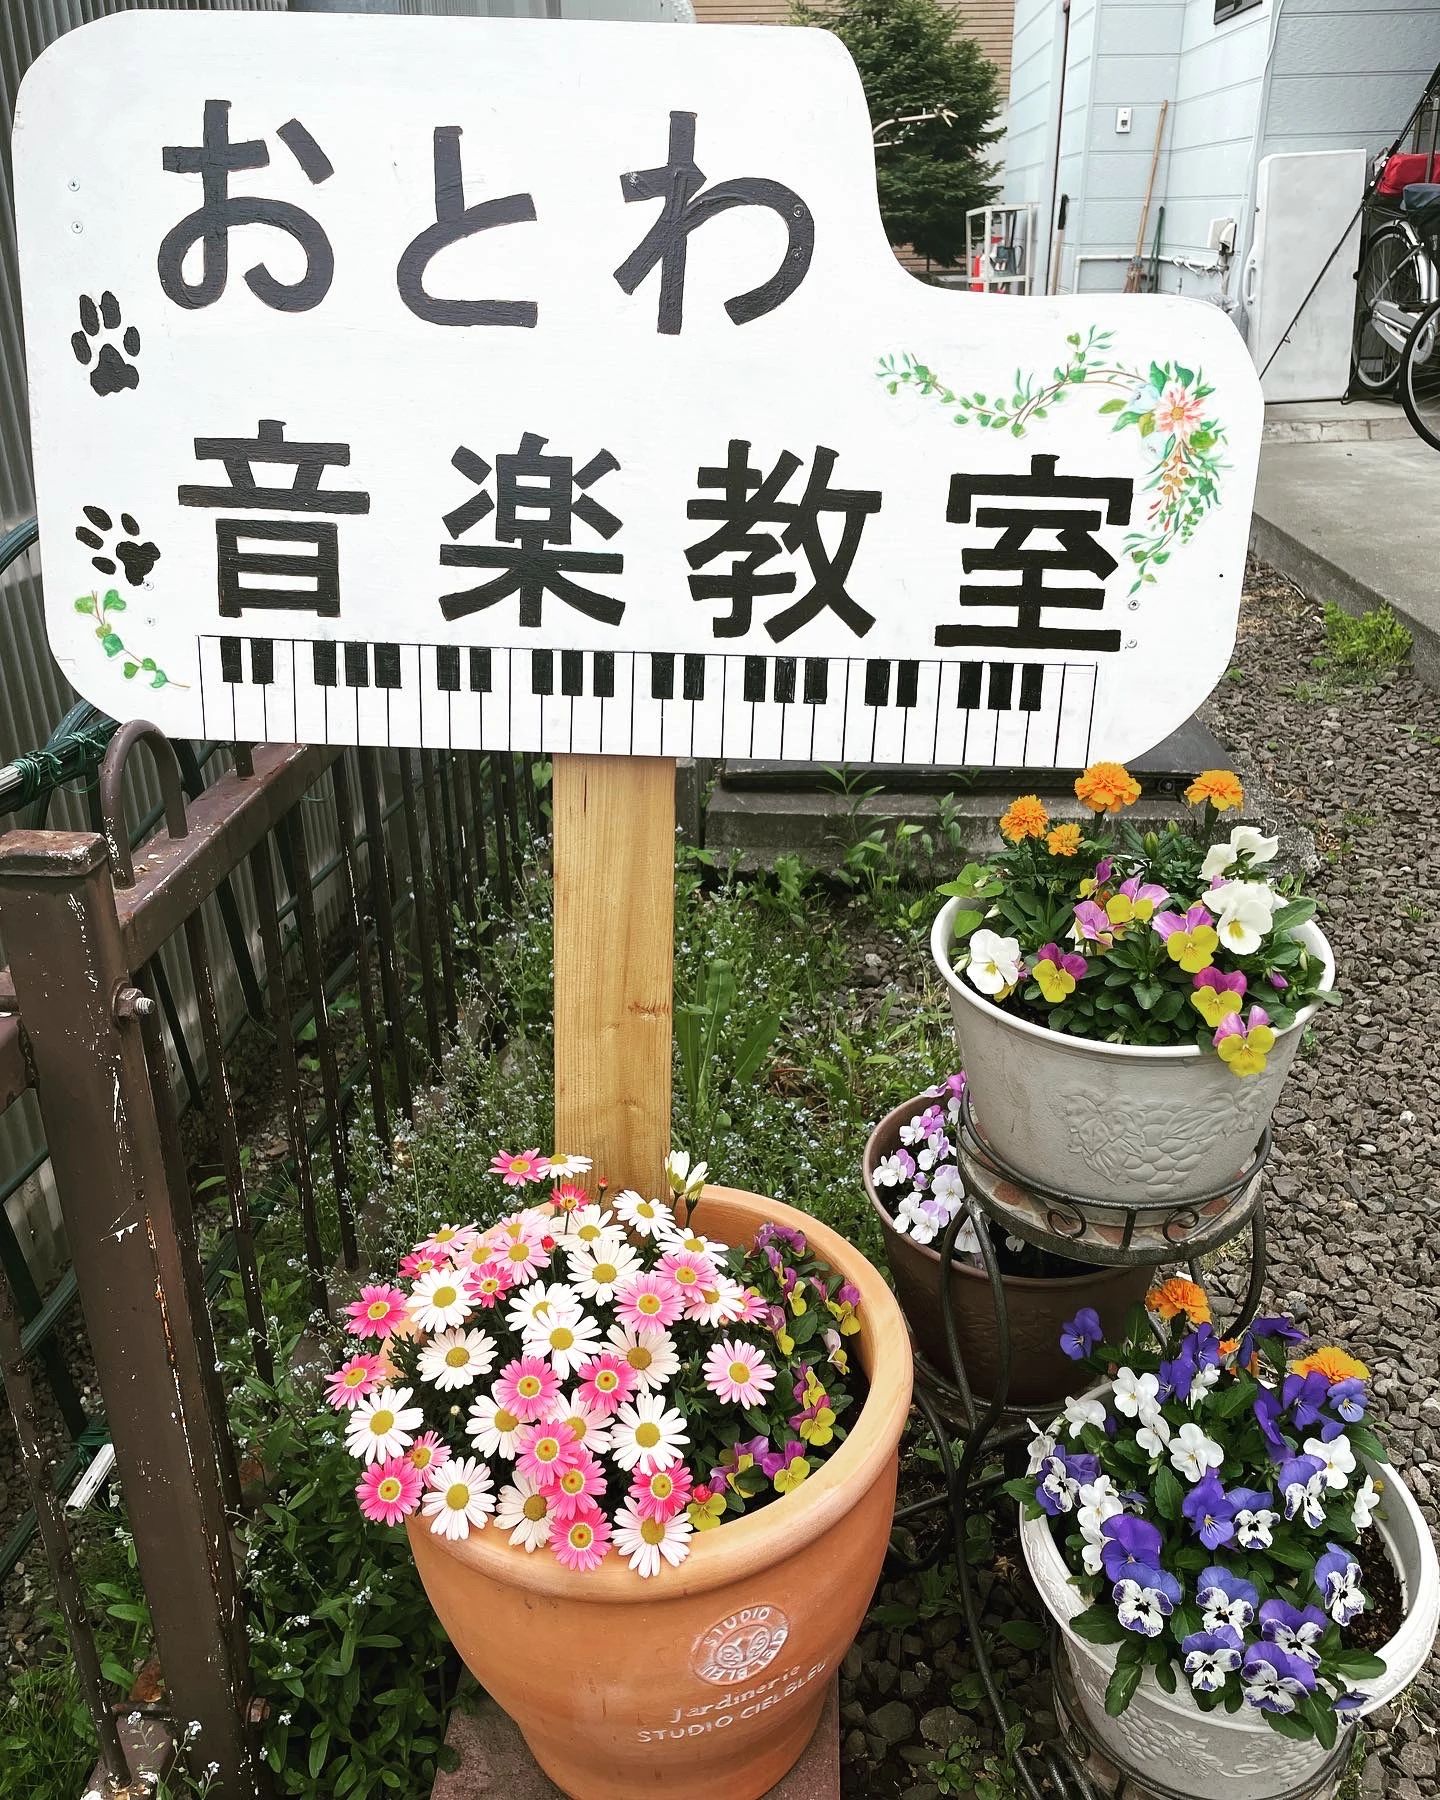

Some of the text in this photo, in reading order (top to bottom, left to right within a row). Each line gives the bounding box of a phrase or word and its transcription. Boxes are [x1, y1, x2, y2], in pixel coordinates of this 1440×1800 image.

[157, 99, 815, 336] おとわ
[177, 418, 1134, 652] 音楽教室
[704, 1606, 771, 1647] STUDIO
[637, 1714, 734, 1744] STUDIO
